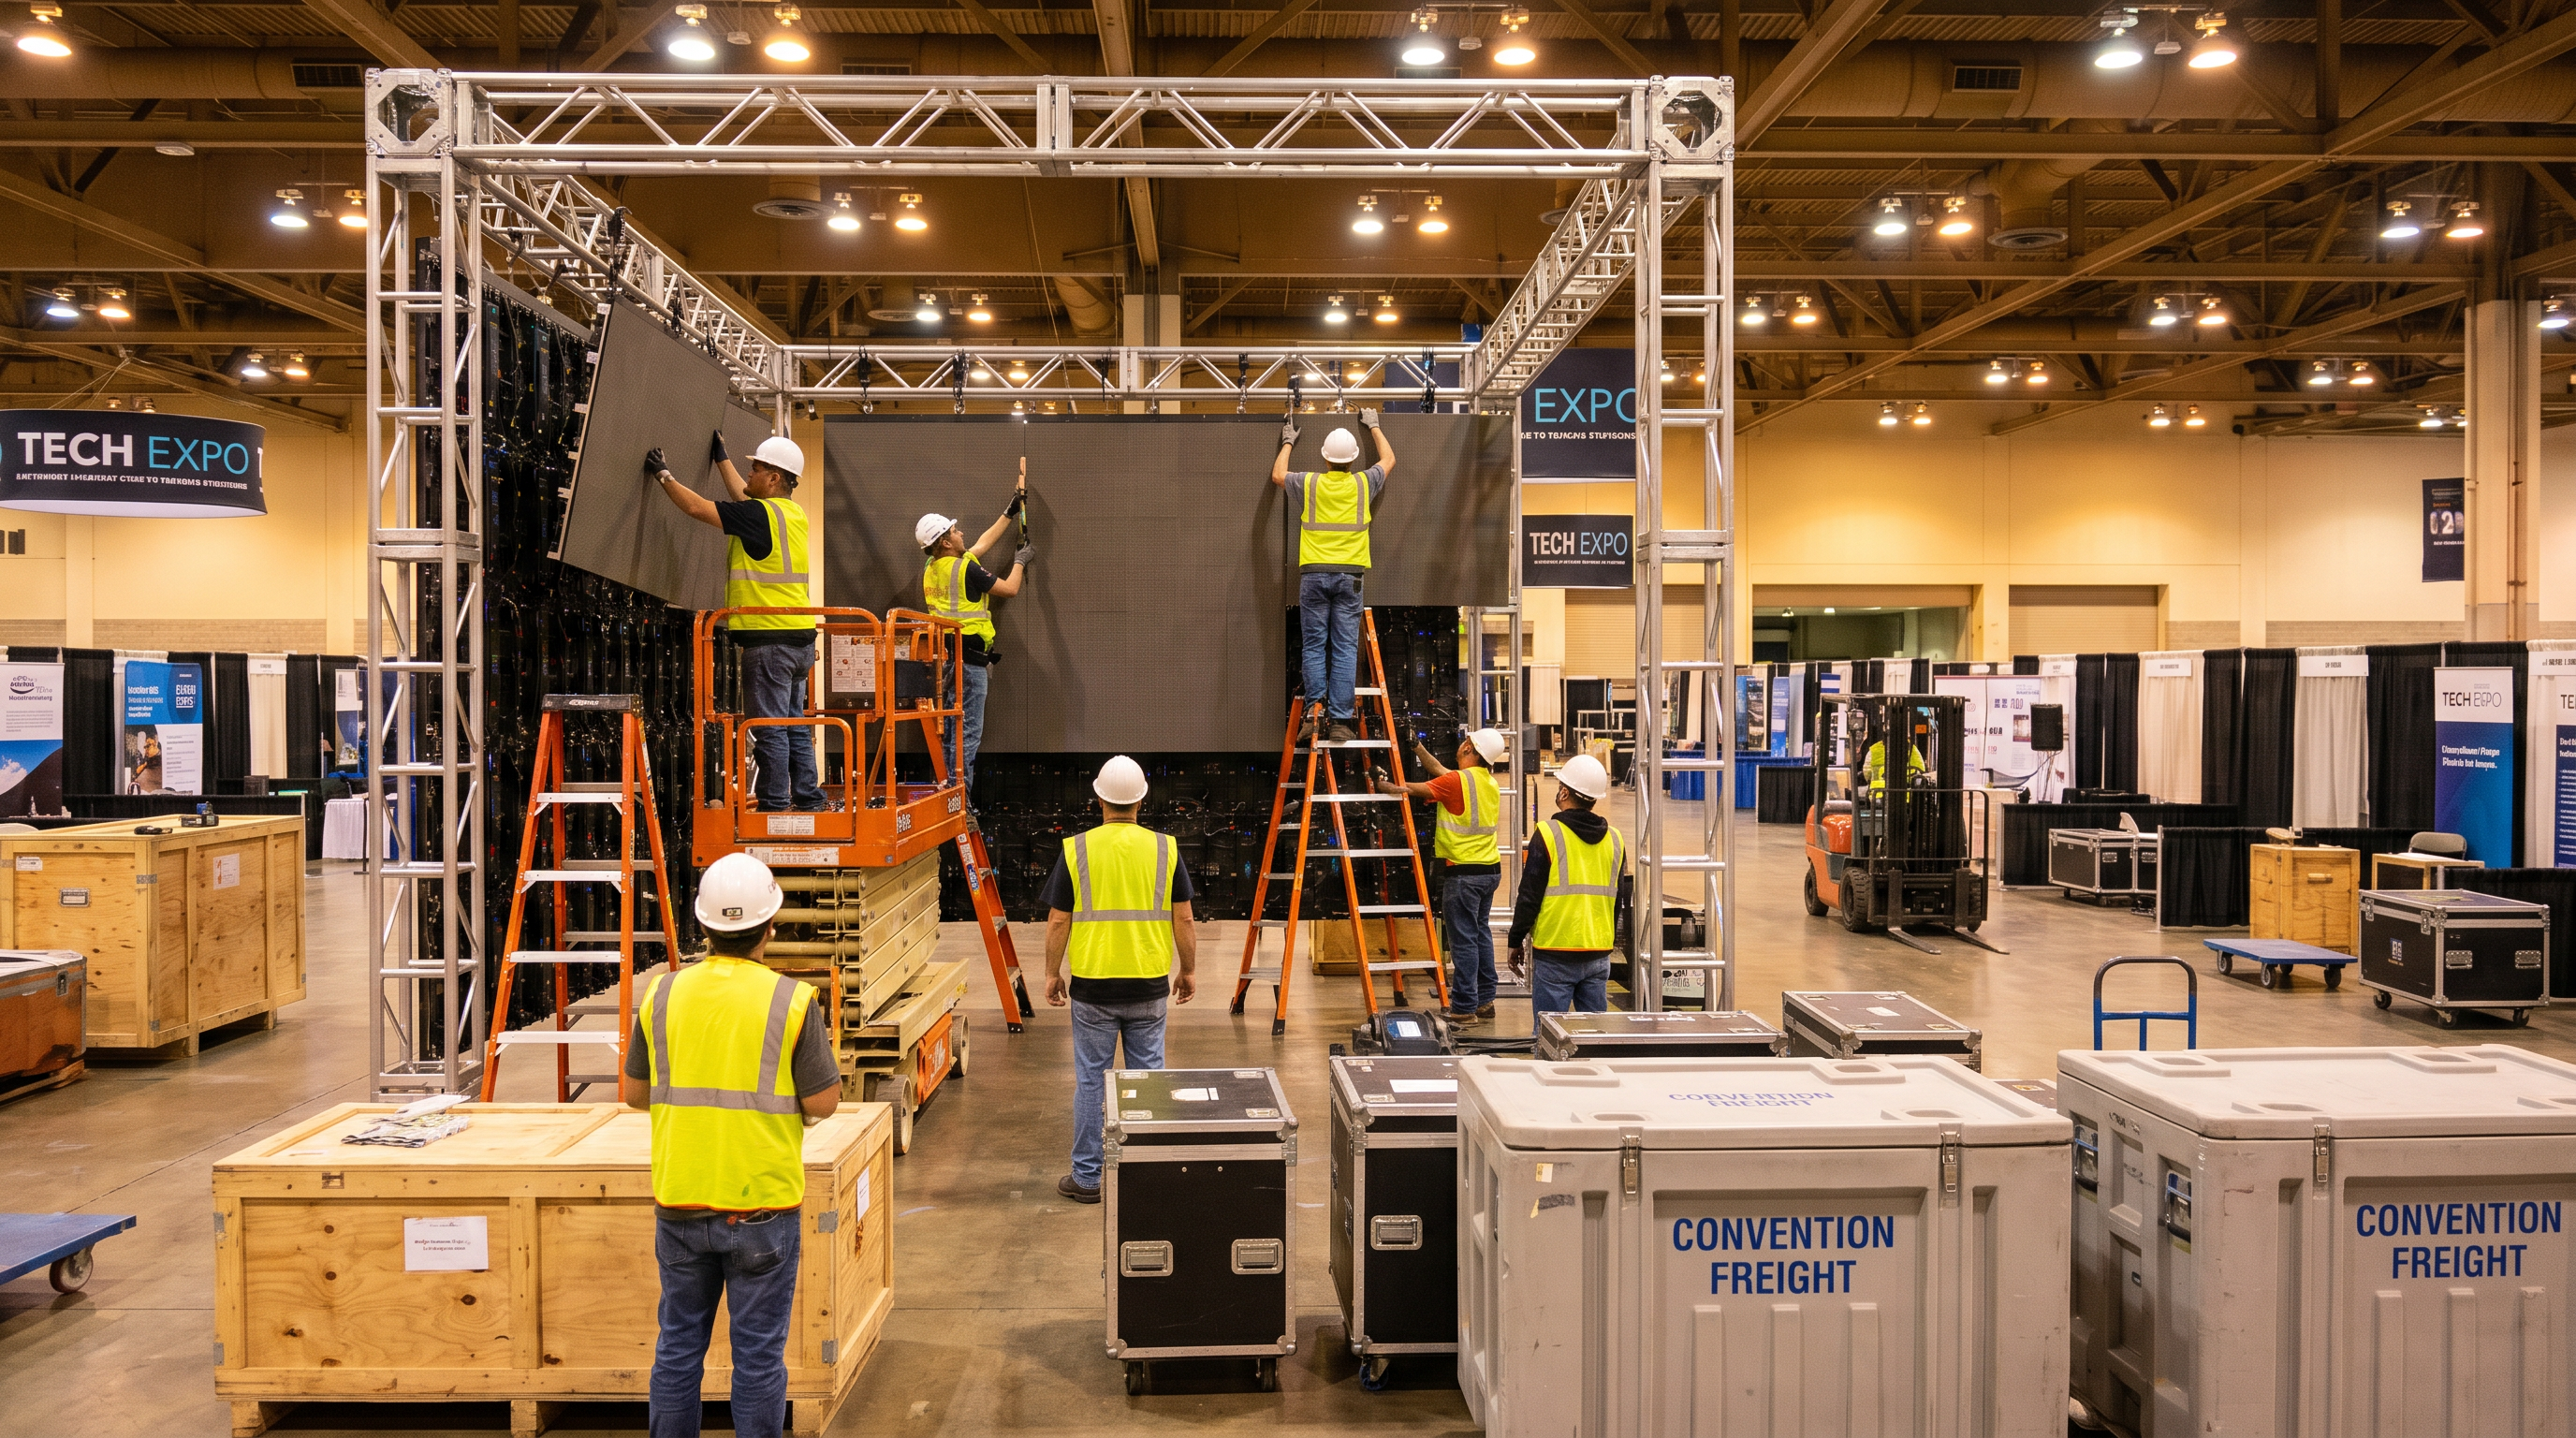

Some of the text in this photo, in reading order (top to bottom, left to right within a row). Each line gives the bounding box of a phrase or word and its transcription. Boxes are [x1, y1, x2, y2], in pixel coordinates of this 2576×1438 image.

[1533, 432, 1546, 440] TO
[17, 432, 133, 467] TECH
[148, 435, 250, 475] EXPO
[1530, 532, 1628, 556] TECH EXPO
[2442, 692, 2471, 707] TECH
[2560, 694, 2576, 710] TE
[1673, 1215, 1894, 1251] CONVENTION
[2357, 1201, 2561, 1237] CONVENTION
[1711, 1260, 1856, 1295] FREIGHT
[2393, 1245, 2527, 1279] FREIGHT
